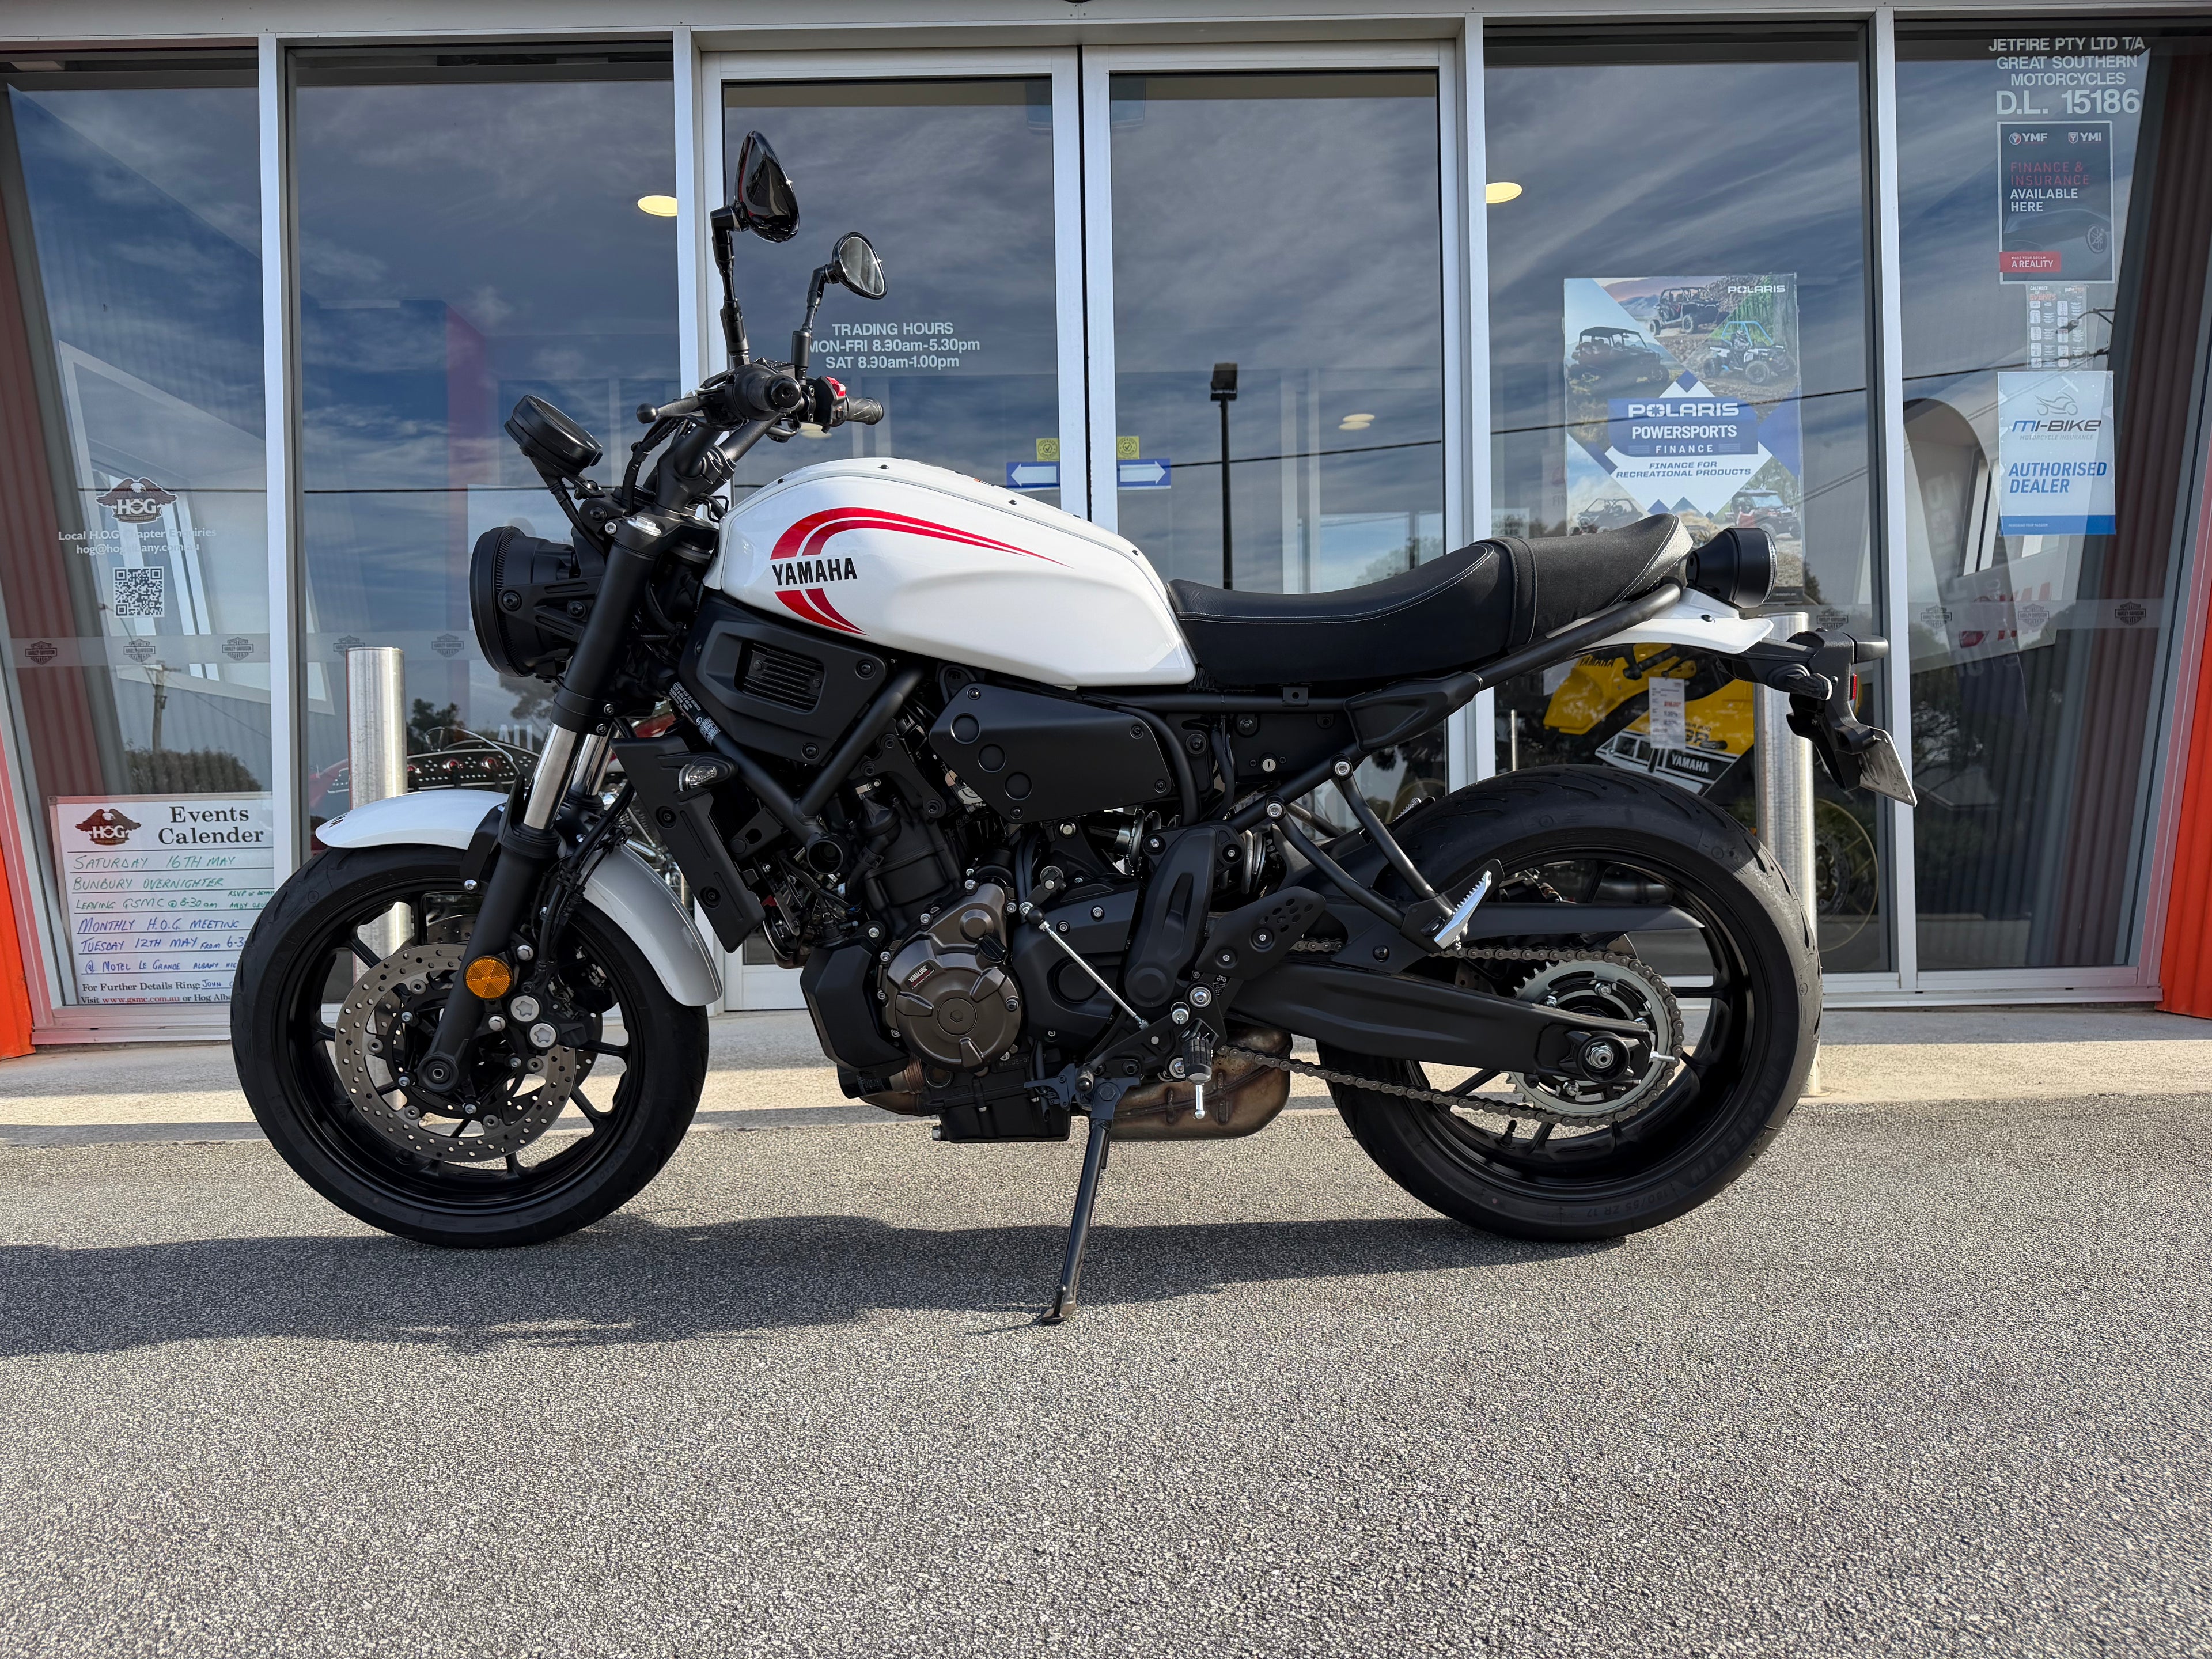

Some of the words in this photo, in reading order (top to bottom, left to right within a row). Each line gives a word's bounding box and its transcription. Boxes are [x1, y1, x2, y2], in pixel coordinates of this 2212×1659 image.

[1989, 38, 2050, 51] JETFIRE
[2055, 37, 2086, 51] PTY
[2090, 37, 2118, 50] LTD
[2123, 36, 2146, 51] T/A
[1996, 56, 2047, 70] GREAT
[2052, 55, 2138, 69] SOUTHERN
[2010, 72, 2126, 86] MOTORCYCLES
[1996, 90, 2048, 115] D.L.
[2062, 88, 2141, 114] 15186
[2022, 132, 2048, 142] YMF
[2080, 132, 2102, 142] YMI
[2010, 162, 2069, 173] FINANCE
[2075, 162, 2084, 172] &
[2010, 175, 2089, 186] INSURANCE
[2010, 188, 2078, 199] AVAILABLE
[2010, 202, 2044, 213] HERE
[2012, 260, 2018, 268] A
[2019, 260, 2054, 268] REALITY
[1728, 285, 1786, 293] POLARIS
[832, 323, 898, 336] TRADING
[903, 322, 954, 335] HOURS
[809, 340, 868, 353] MON-FRI
[825, 356, 854, 369] SAT
[1628, 403, 1739, 418] POLARIS
[1632, 425, 1737, 440] POWERSPORTS
[1656, 444, 1713, 454] FINANCE
[1649, 461, 1695, 469] FINANCE
[2008, 461, 2107, 477] AUTHORISED
[1616, 469, 1694, 478] RECREATIONAL
[1695, 468, 1751, 476] PRODUCTS
[2009, 478, 2070, 494] DEALER
[116, 498, 157, 515] HOG
[58, 531, 86, 541] Local
[771, 558, 858, 586] YAMAHA
[1672, 753, 1709, 773] YAMAHA
[169, 806, 249, 823] Events
[92, 825, 126, 839] HOG
[158, 826, 264, 845] Calender
[74, 855, 148, 869] SATURDAY
[206, 856, 236, 866] MAY
[73, 876, 133, 891] BUNBURY
[143, 877, 224, 889] OVERNIGHTER
[76, 900, 115, 910] LEAVING
[123, 898, 165, 908] GSMC
[168, 900, 177, 908] @
[78, 919, 135, 933] MONTHLY
[190, 919, 240, 929] MEETING
[81, 938, 124, 952] TUESDAY
[135, 938, 161, 948] 12TH
[170, 937, 199, 948] MAY
[200, 942, 221, 950] FROM
[85, 960, 95, 974] @
[103, 960, 131, 971] MOTEL
[138, 960, 147, 969] LE
[152, 959, 181, 971] GRANDE
[82, 983, 98, 991] For
[100, 982, 138, 991] Further
[140, 981, 173, 990] Details
[175, 981, 201, 991] Ring:
[202, 979, 222, 988] JOHN
[81, 996, 101, 1004] Visit
[101, 995, 180, 1005] www.gsmc.com.au
[193, 994, 212, 1004] Hog
[1689, 1067, 1781, 1183] MICHELIN
